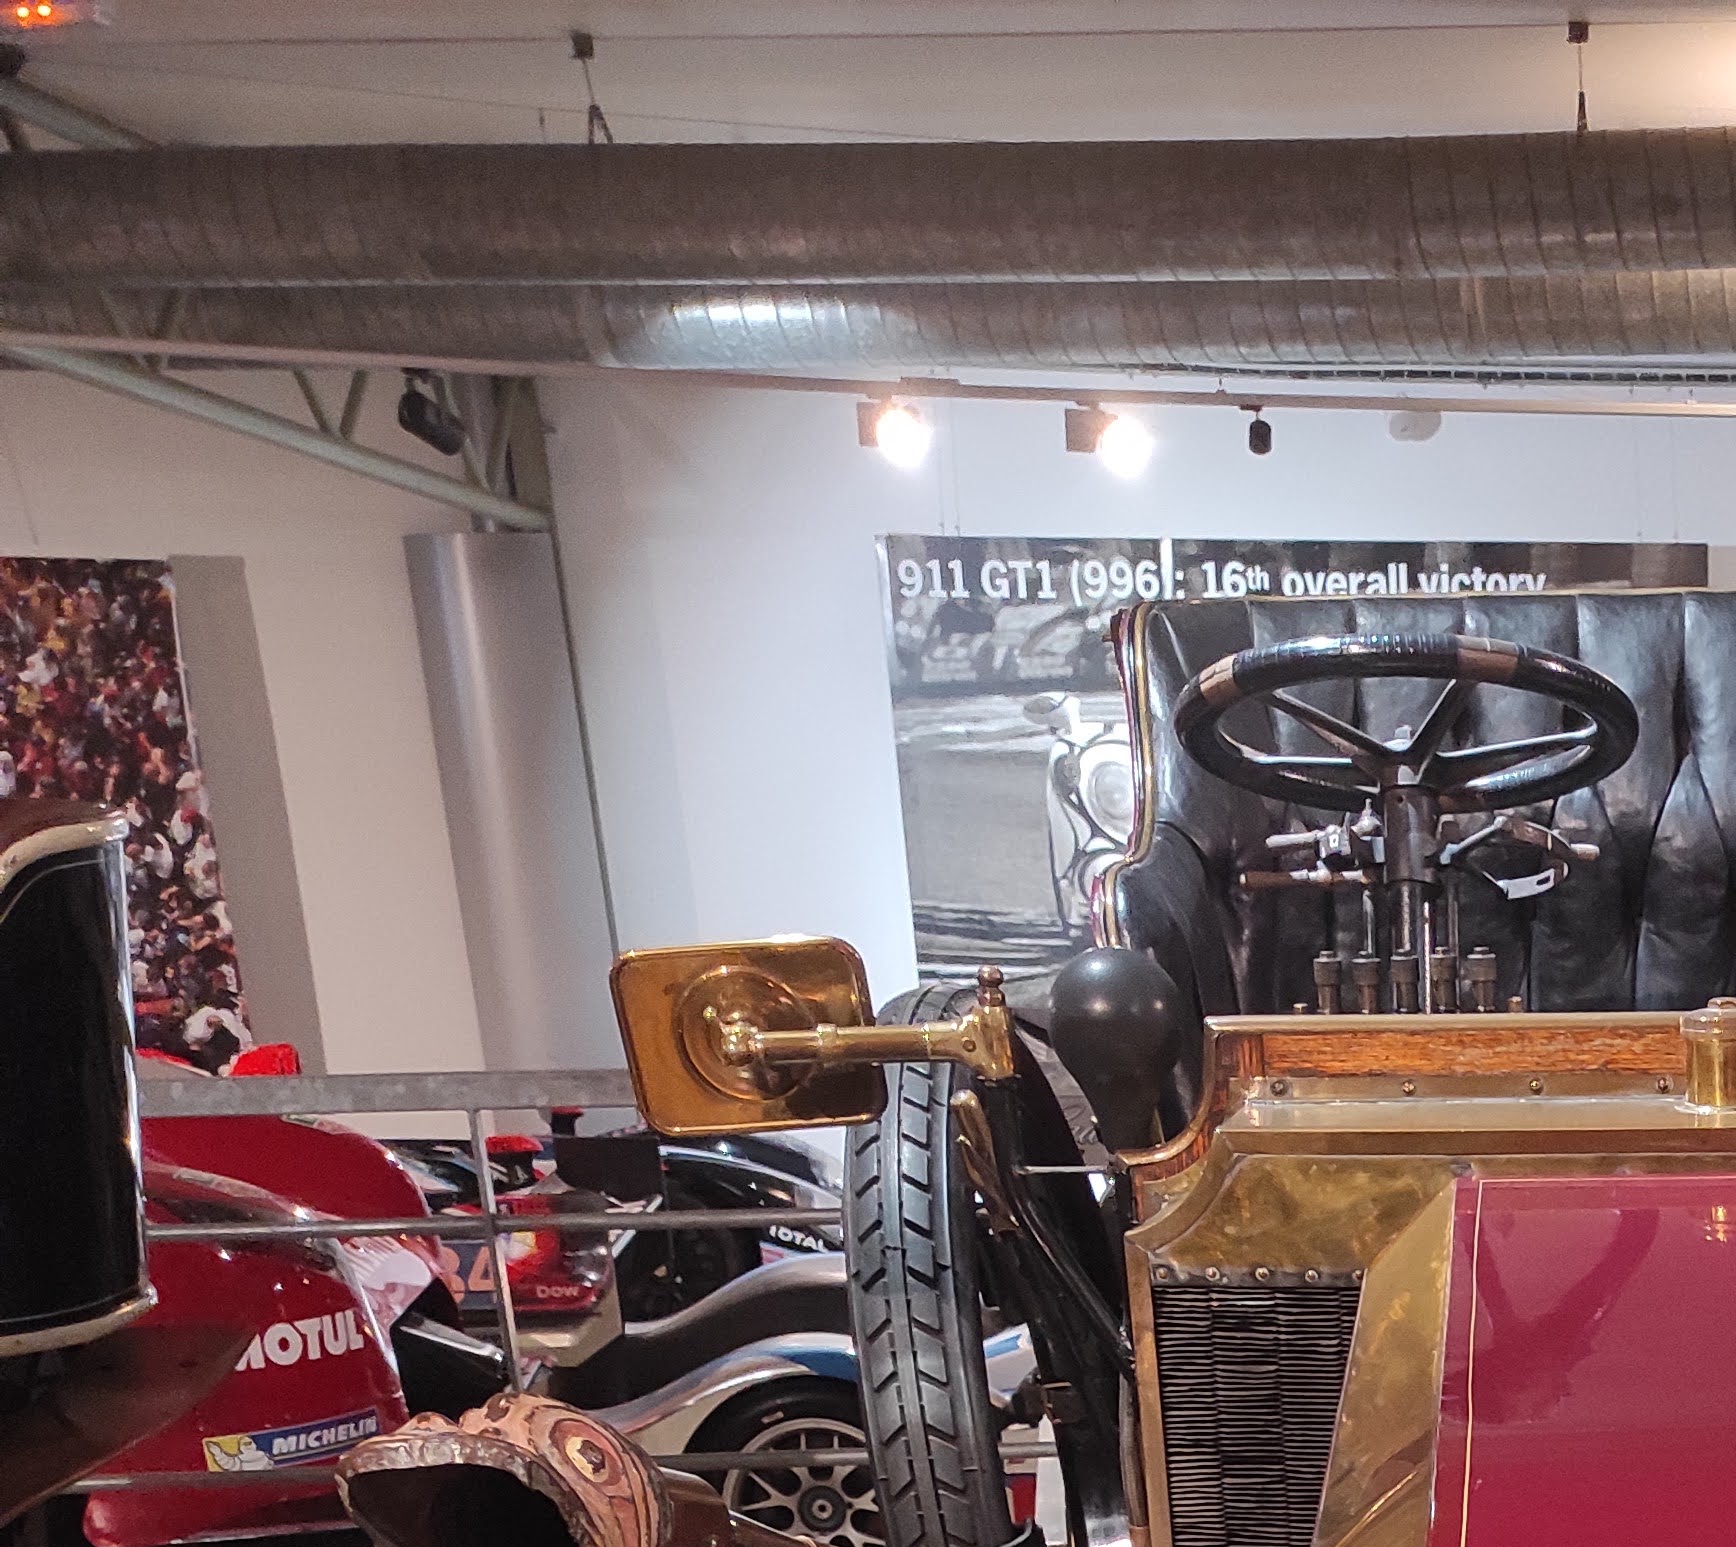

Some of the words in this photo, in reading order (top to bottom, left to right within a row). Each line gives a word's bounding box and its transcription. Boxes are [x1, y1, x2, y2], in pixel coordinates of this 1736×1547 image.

[898, 559, 969, 598] 911
[981, 559, 1057, 600] GT1
[1201, 560, 1271, 598] 16th
[1281, 563, 1408, 596] overall
[1417, 563, 1547, 593] victory
[536, 1285, 579, 1298] DOW
[272, 1416, 377, 1455] MICHELIN
